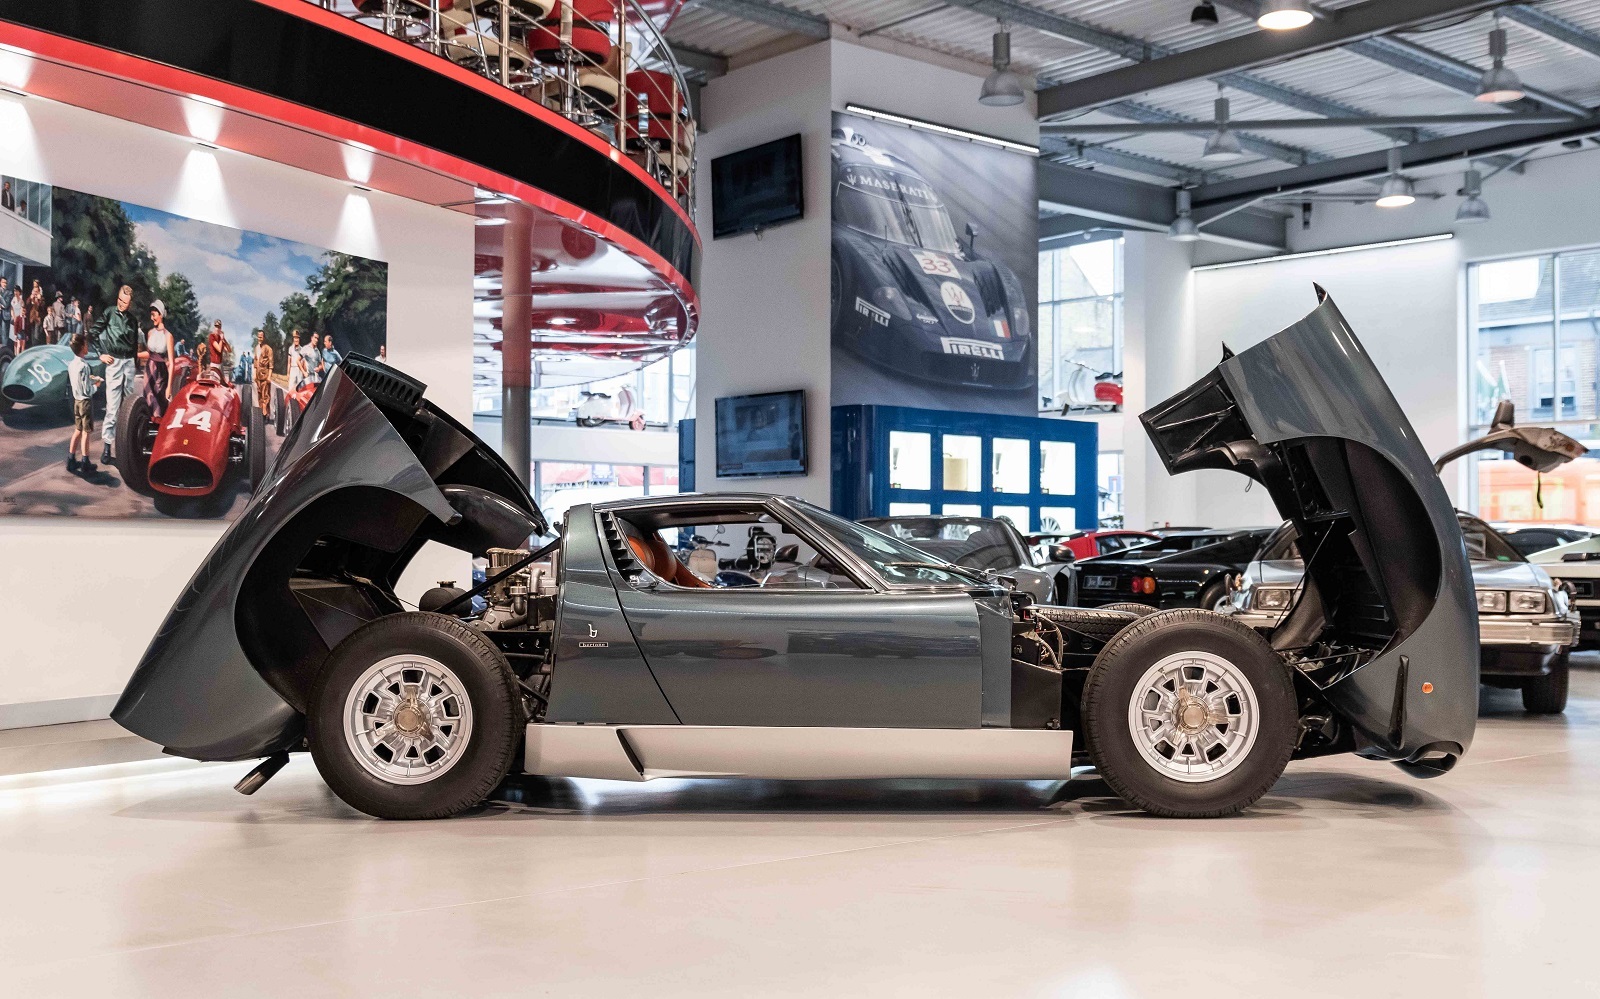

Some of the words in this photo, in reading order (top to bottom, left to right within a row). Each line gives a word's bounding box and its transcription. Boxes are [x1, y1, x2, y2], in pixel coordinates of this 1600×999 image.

[860, 175, 929, 199] MASERATI
[922, 259, 951, 273] 33
[940, 337, 1005, 360] PIRELLI
[27, 363, 52, 384] 18
[167, 408, 212, 432] 14
